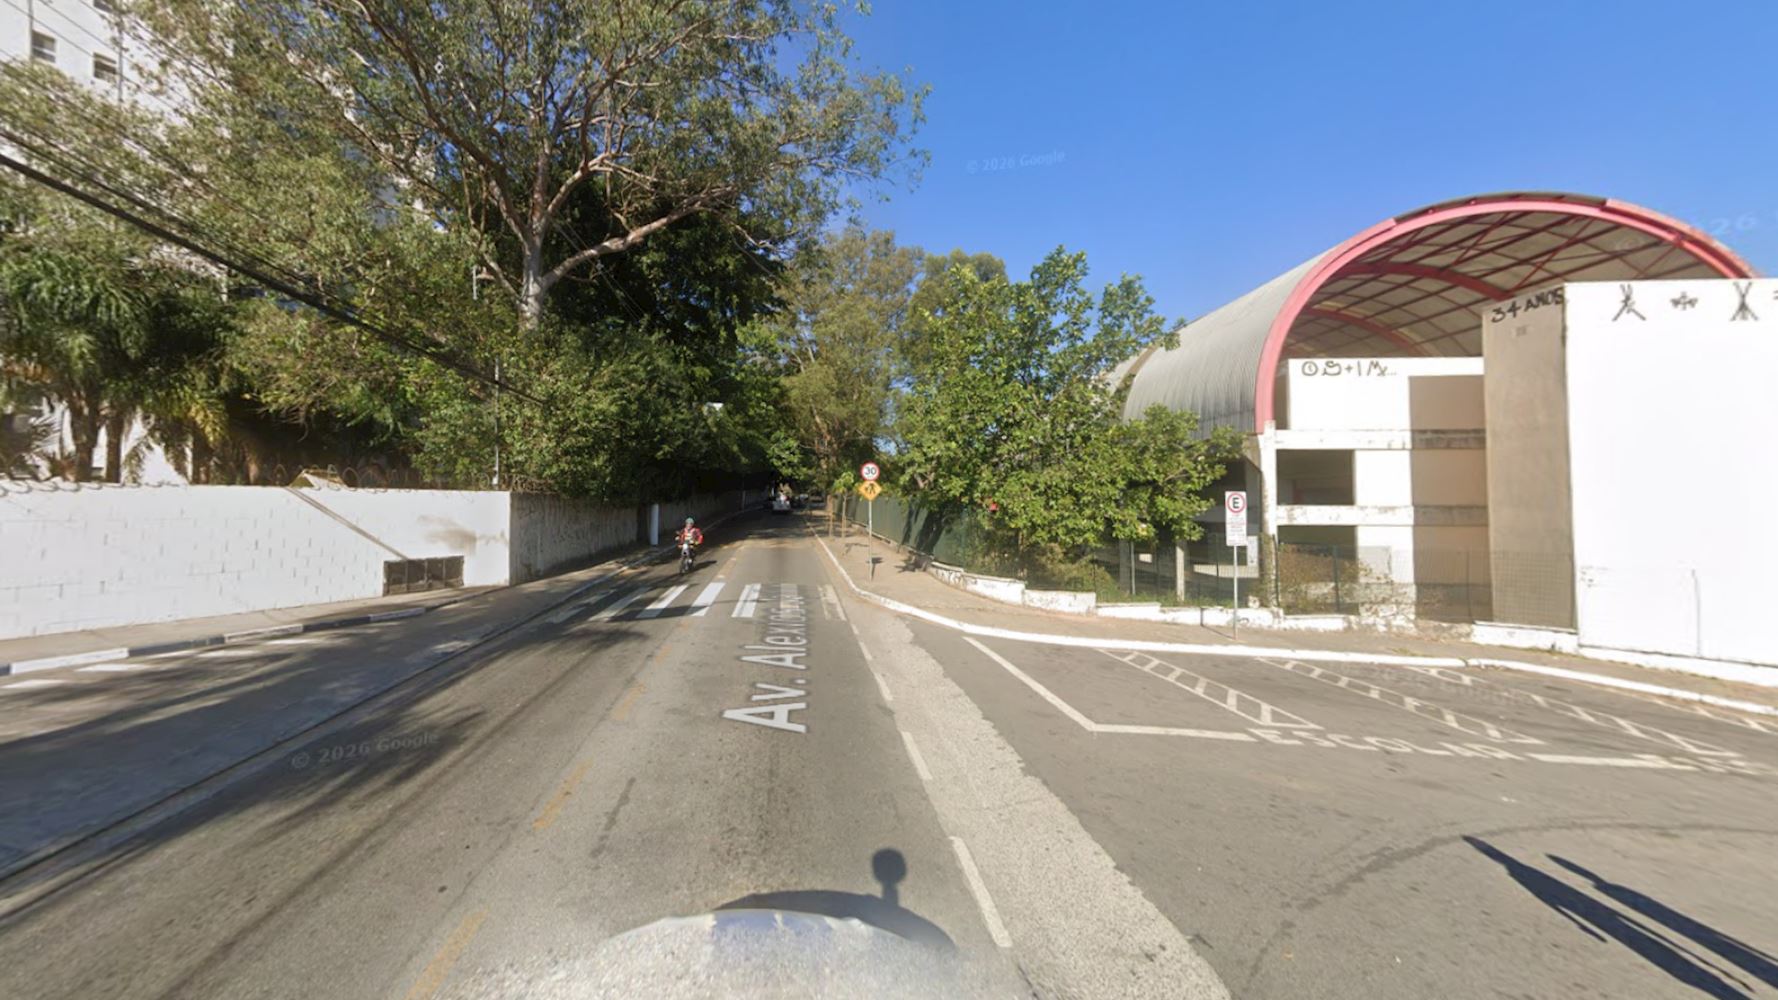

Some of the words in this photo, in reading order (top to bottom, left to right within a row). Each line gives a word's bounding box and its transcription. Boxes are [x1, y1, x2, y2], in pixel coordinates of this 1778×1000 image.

[864, 466, 877, 476] 30
[1232, 497, 1240, 509] E
[1246, 727, 1527, 761] ESCOLAR
